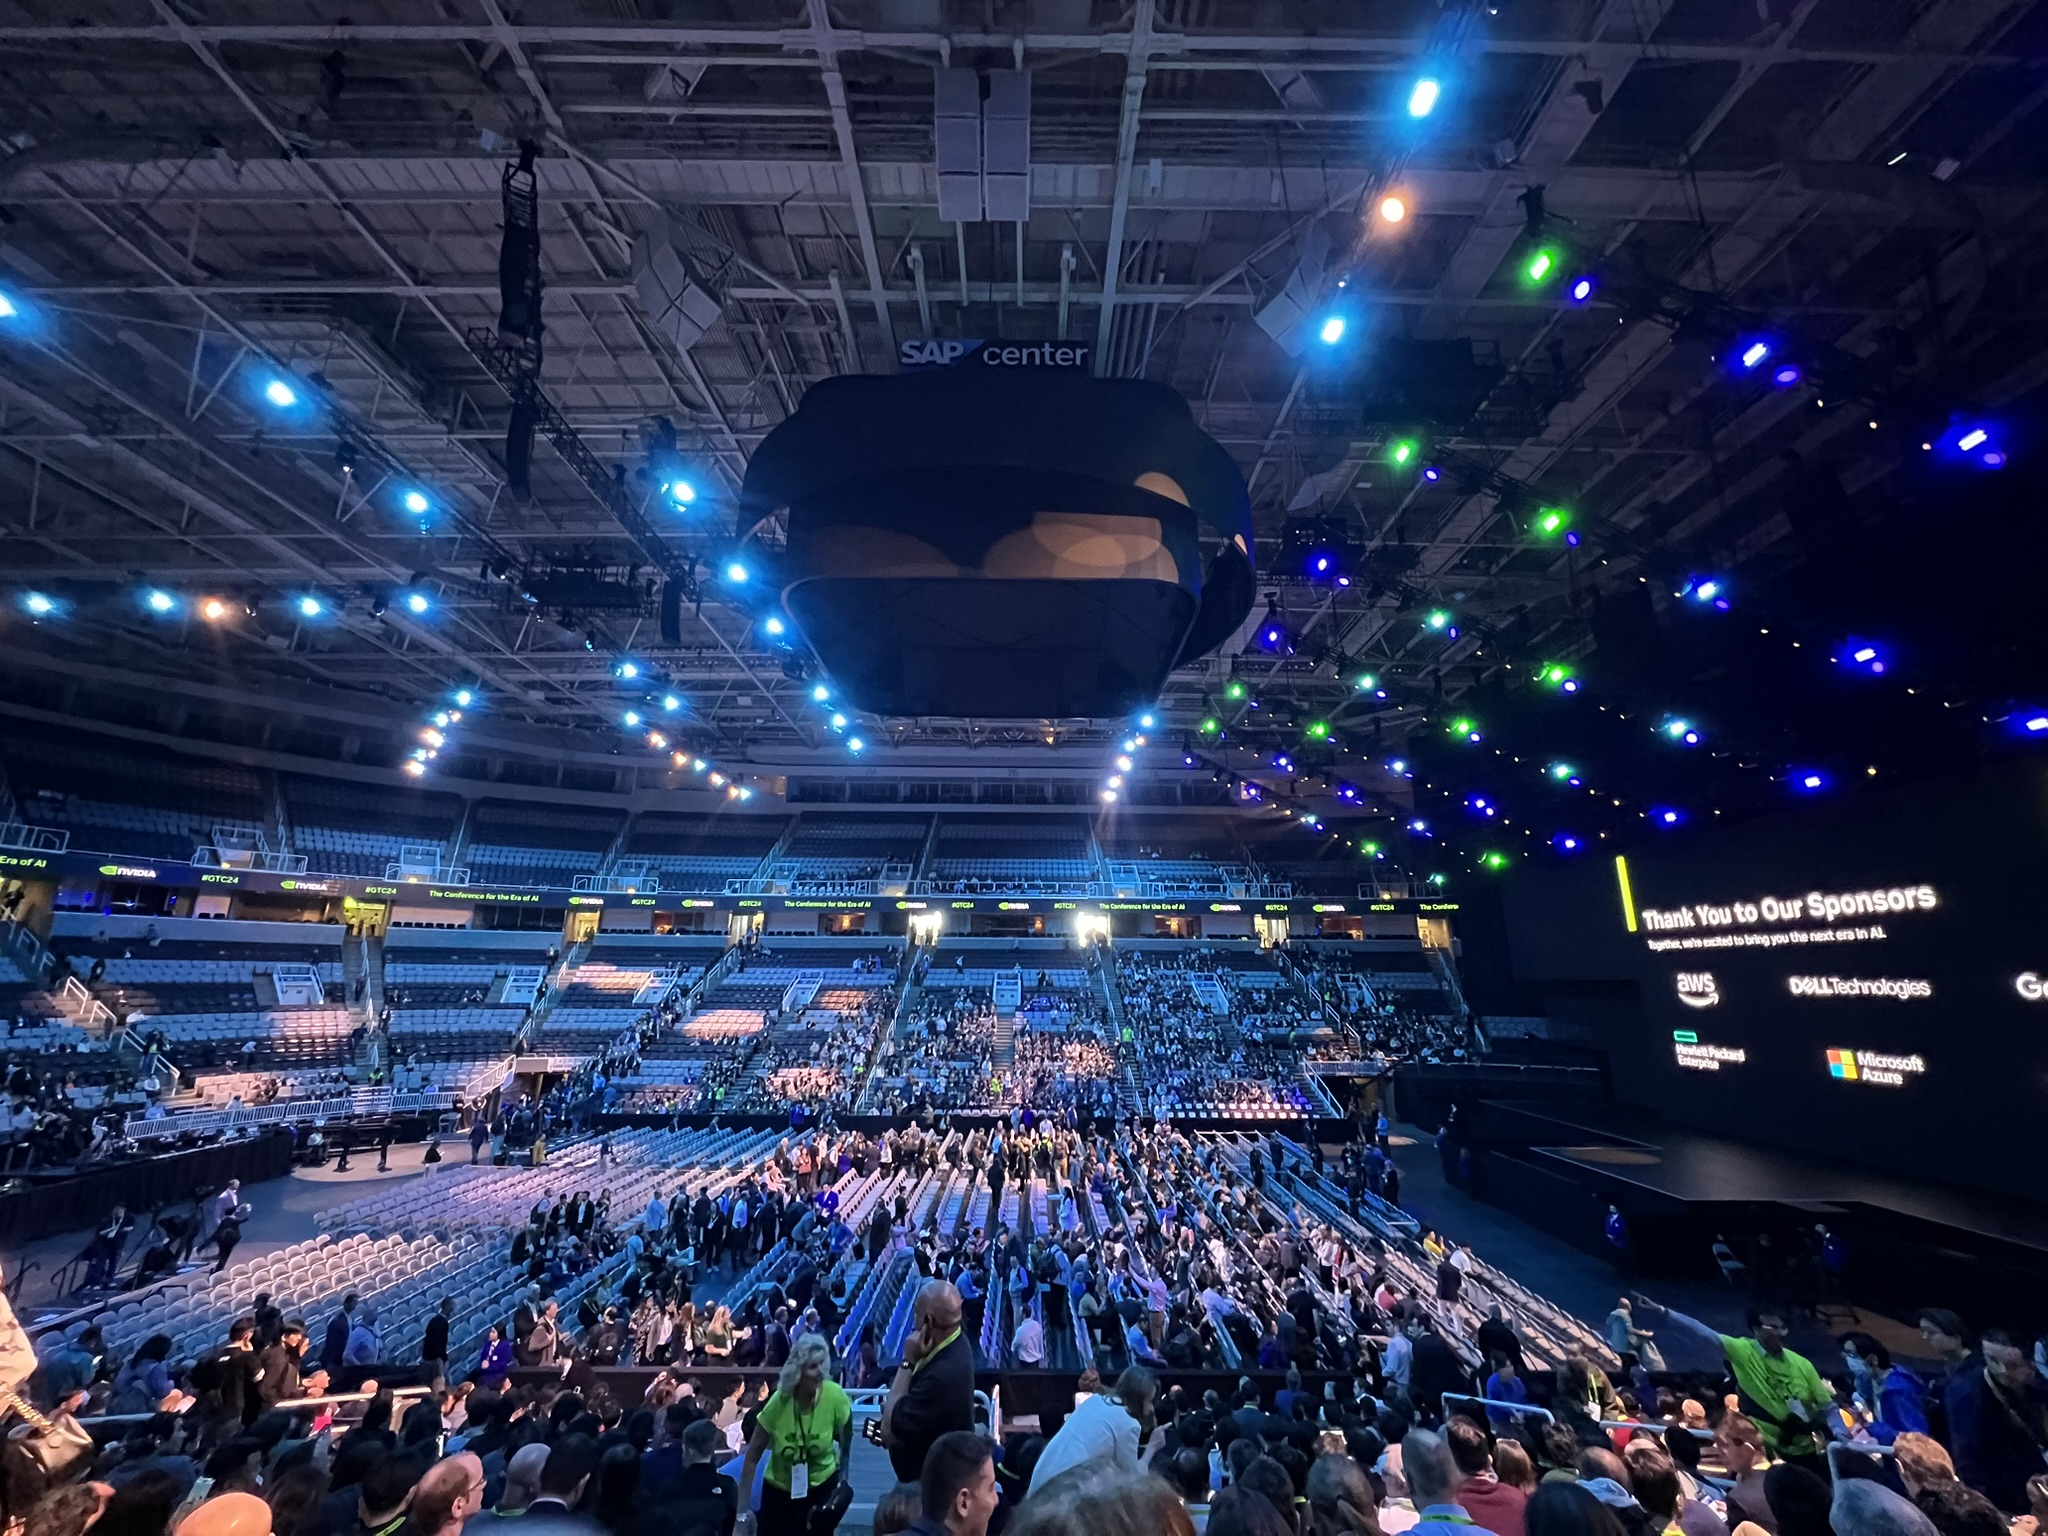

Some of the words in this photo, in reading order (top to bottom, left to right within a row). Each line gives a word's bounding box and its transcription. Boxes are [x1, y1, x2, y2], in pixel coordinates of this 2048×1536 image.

[901, 340, 965, 364] SAP
[983, 342, 1089, 366] center
[0, 855, 18, 864] Era
[34, 860, 47, 868] AI
[117, 867, 156, 878] NVIDIA
[201, 874, 239, 884] #GTC24
[295, 881, 328, 891] NVIDIA
[365, 886, 397, 895] #GTC24
[429, 890, 443, 898] The
[444, 891, 485, 900] Conference
[1642, 906, 1696, 931] Thank
[1695, 904, 1732, 926] You
[1733, 901, 1759, 924] to
[1760, 896, 1803, 921] Our
[1806, 884, 1937, 922] Sponsors
[1647, 939, 1682, 952] Together,
[1682, 938, 1703, 948] we're
[1703, 935, 1733, 948] excited
[1733, 935, 1745, 946] to
[1744, 933, 1771, 947] bring
[1770, 933, 1789, 946] you
[1790, 931, 1809, 943] the
[1809, 930, 1835, 942] next
[1835, 930, 1855, 941] era
[1855, 927, 1868, 940] in
[1676, 972, 1716, 993] aws
[1675, 1043, 1709, 1058] Hewlett
[1708, 1045, 1746, 1062] Packard
[1677, 1054, 1720, 1070] Enterprise
[1856, 1051, 1925, 1073] Microsoft
[1862, 1067, 1904, 1085] Azure
